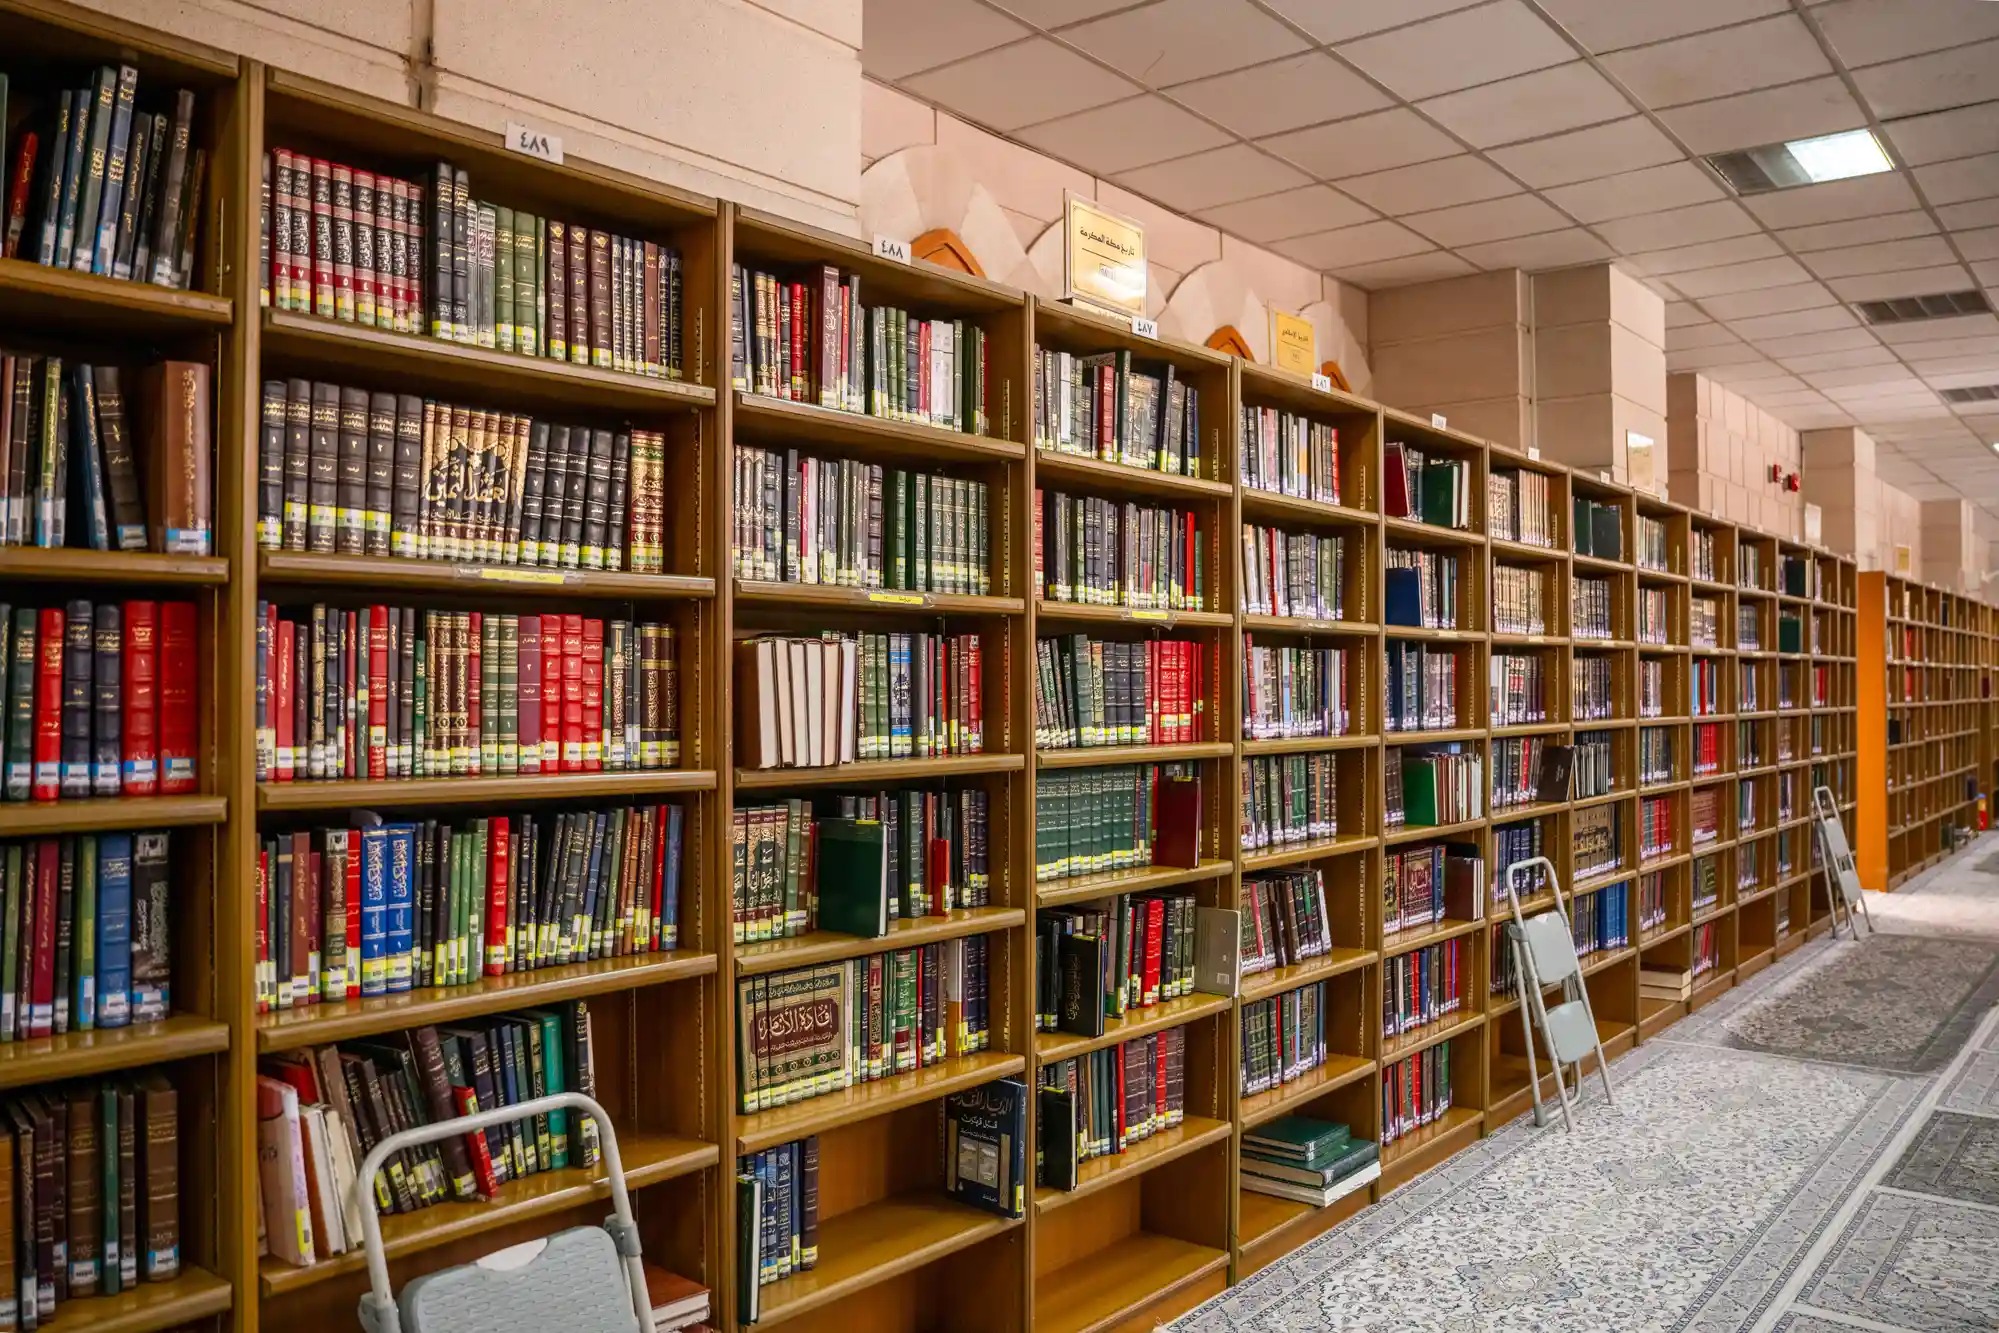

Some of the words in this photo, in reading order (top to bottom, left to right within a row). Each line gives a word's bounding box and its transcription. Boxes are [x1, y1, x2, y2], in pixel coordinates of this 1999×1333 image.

[519, 129, 551, 155] ٤٨٩
[880, 240, 904, 259] ٤٨٨
[1137, 321, 1153, 336] ٤٨٧
